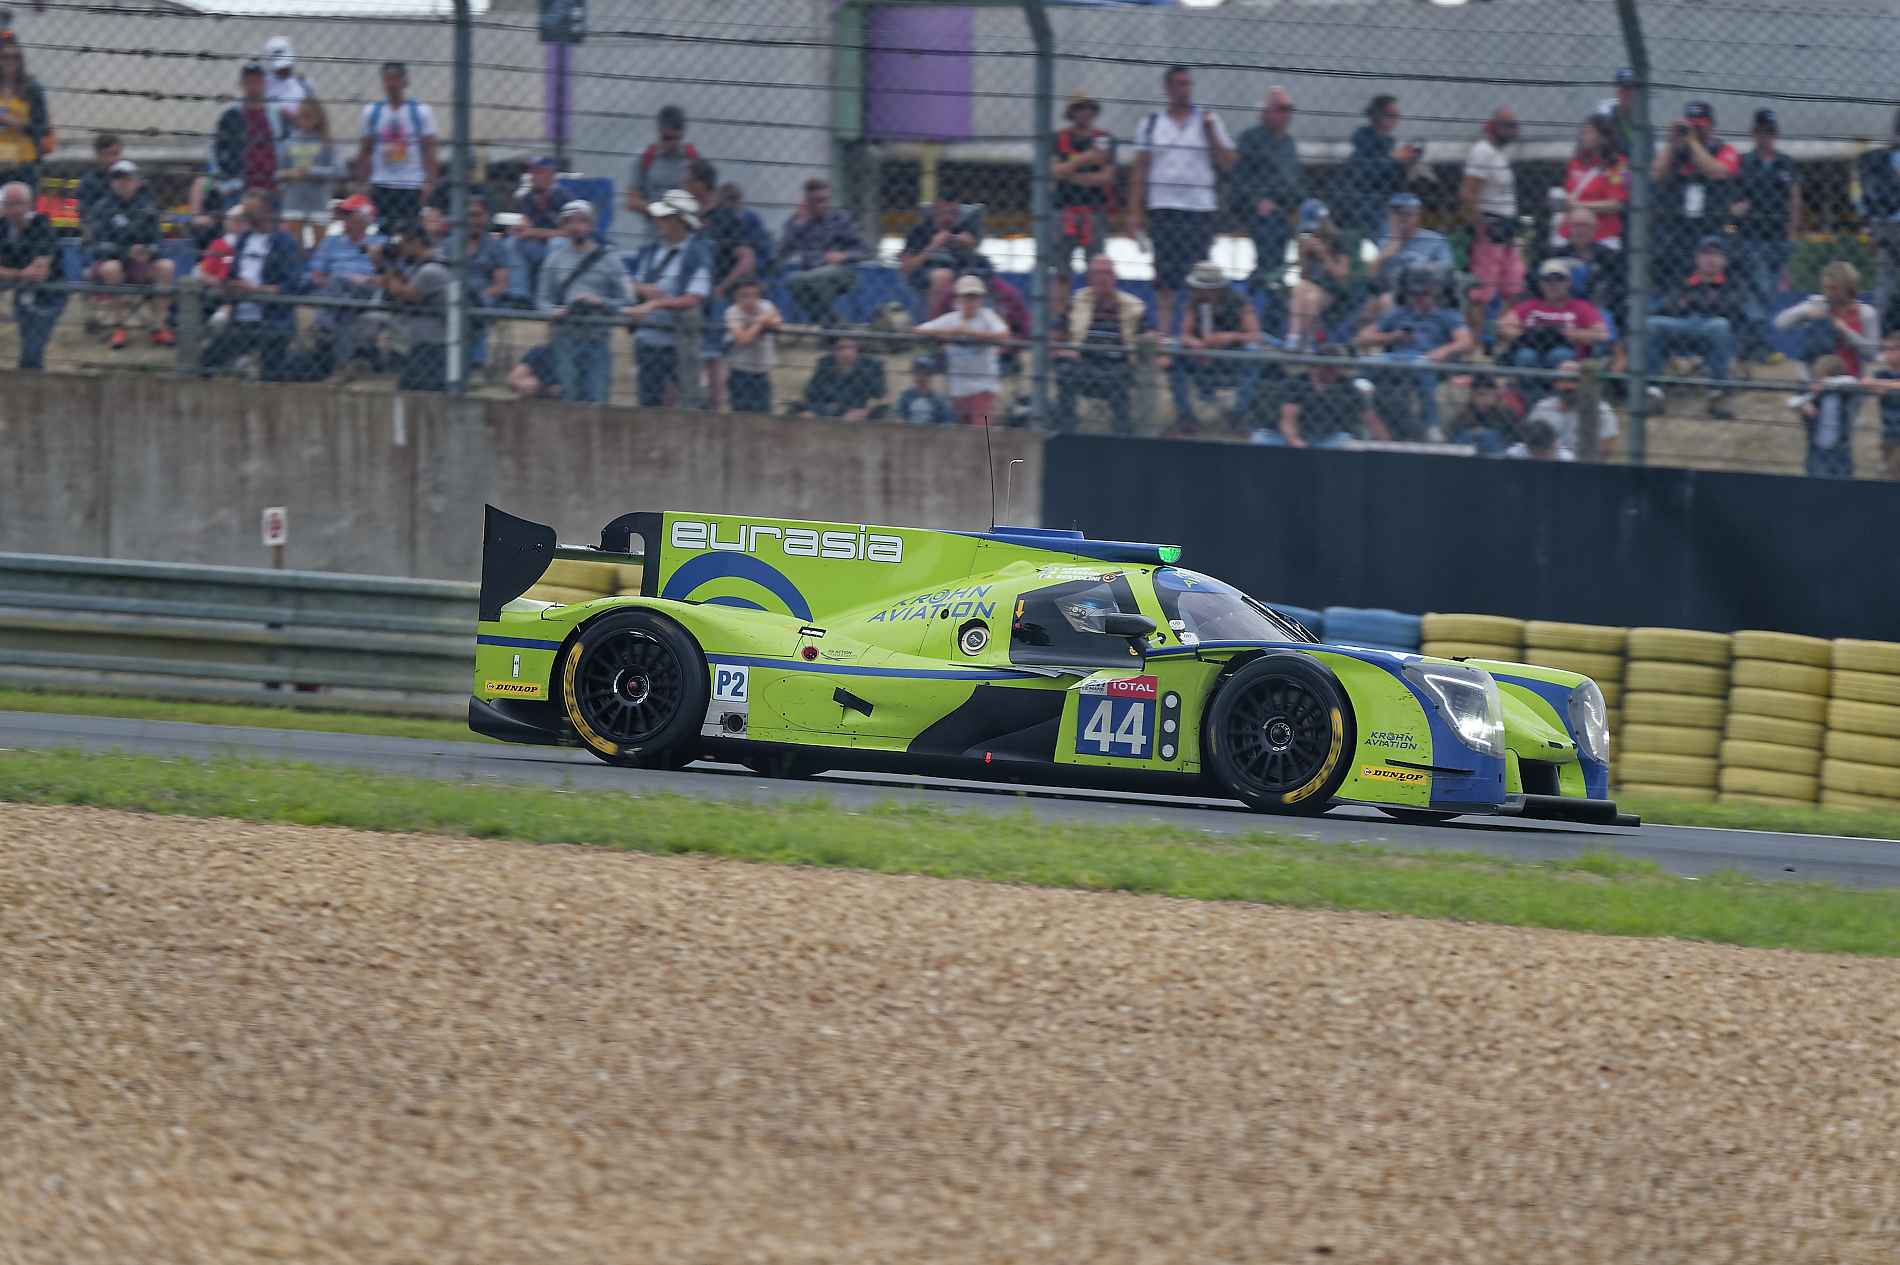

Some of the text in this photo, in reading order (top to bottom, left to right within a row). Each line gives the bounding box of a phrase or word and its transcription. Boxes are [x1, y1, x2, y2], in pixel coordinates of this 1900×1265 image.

[671, 520, 904, 564] eurasia
[866, 601, 996, 623] AVIATION
[495, 684, 538, 693] DUNLOP
[717, 670, 745, 697] P2
[1112, 681, 1155, 693] TOTAL
[1083, 700, 1147, 755] 44
[1370, 731, 1414, 742] KROHN
[1364, 738, 1418, 750] AVIATION
[1373, 769, 1424, 781] DUNLOP
